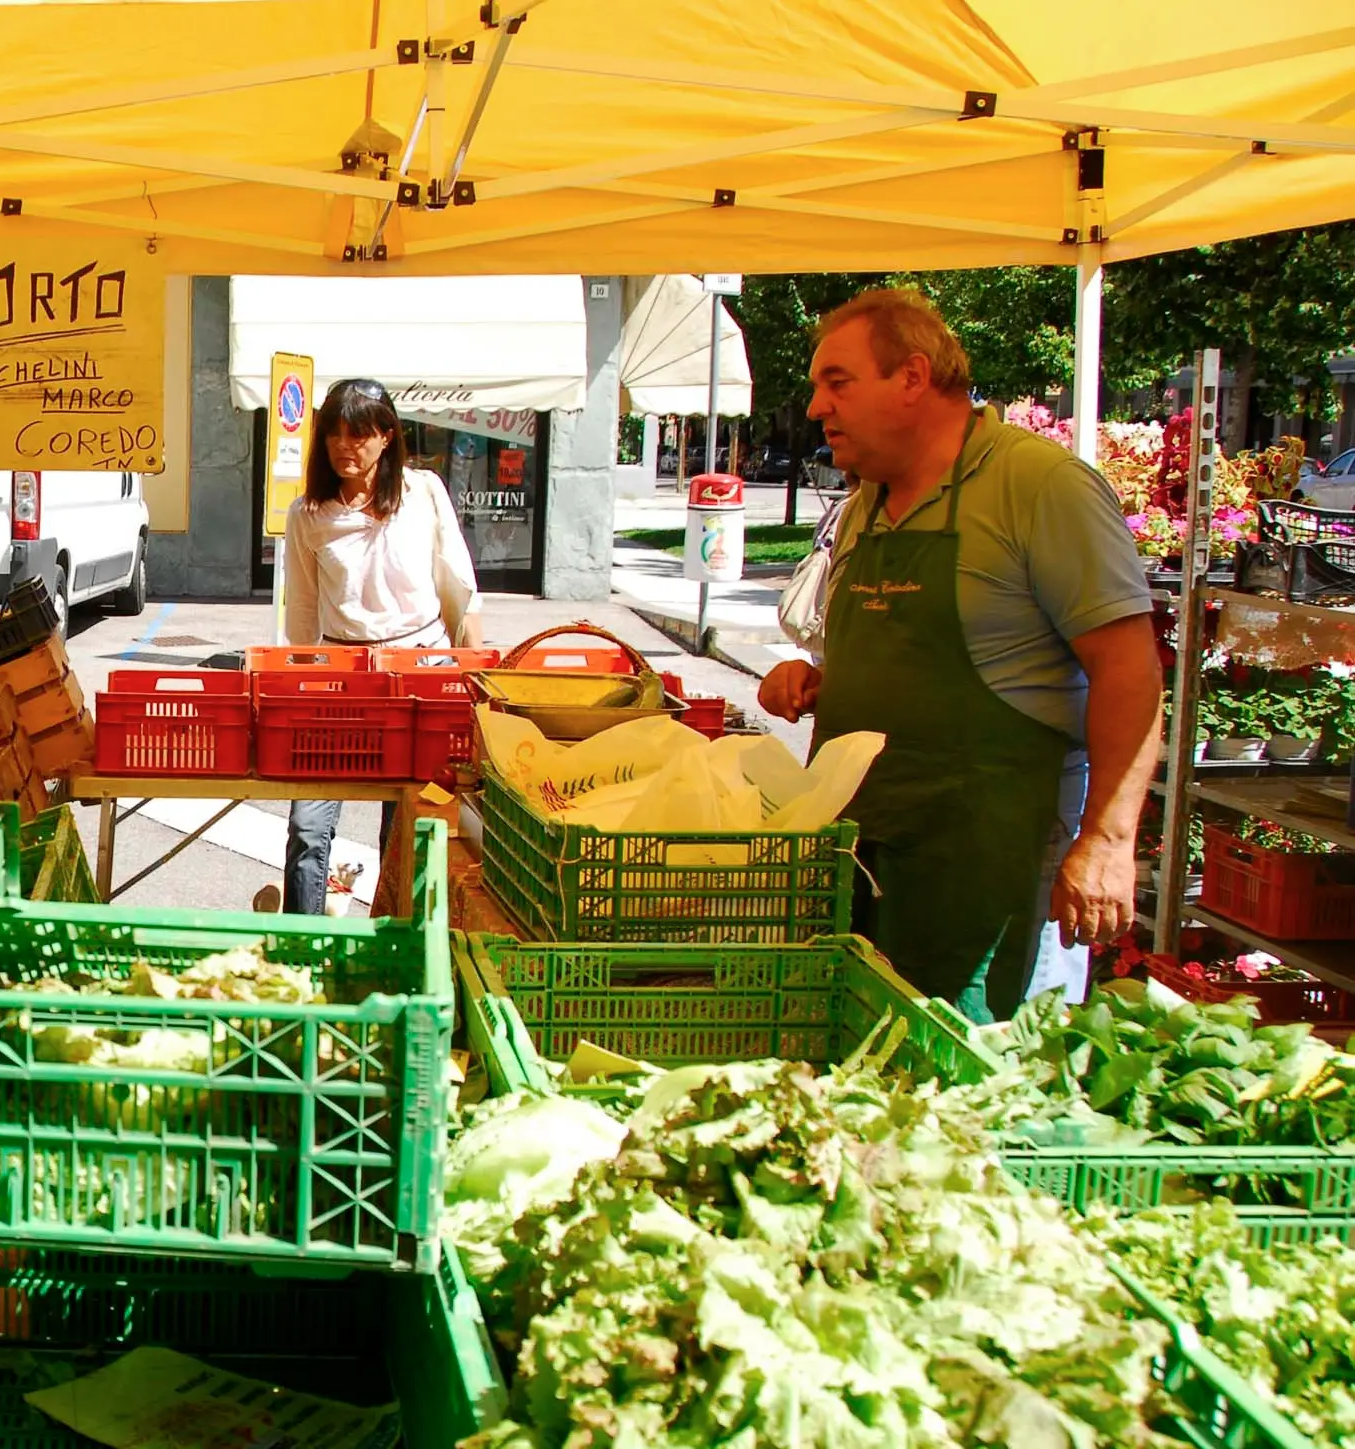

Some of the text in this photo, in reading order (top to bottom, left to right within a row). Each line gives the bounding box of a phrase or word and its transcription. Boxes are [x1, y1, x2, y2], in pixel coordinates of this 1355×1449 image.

[596, 286, 605, 296] 10
[41, 387, 134, 410] MARCO
[15, 420, 157, 458] COREDO
[92, 455, 134, 470] TN
[457, 490, 526, 507] SCOTTINI
